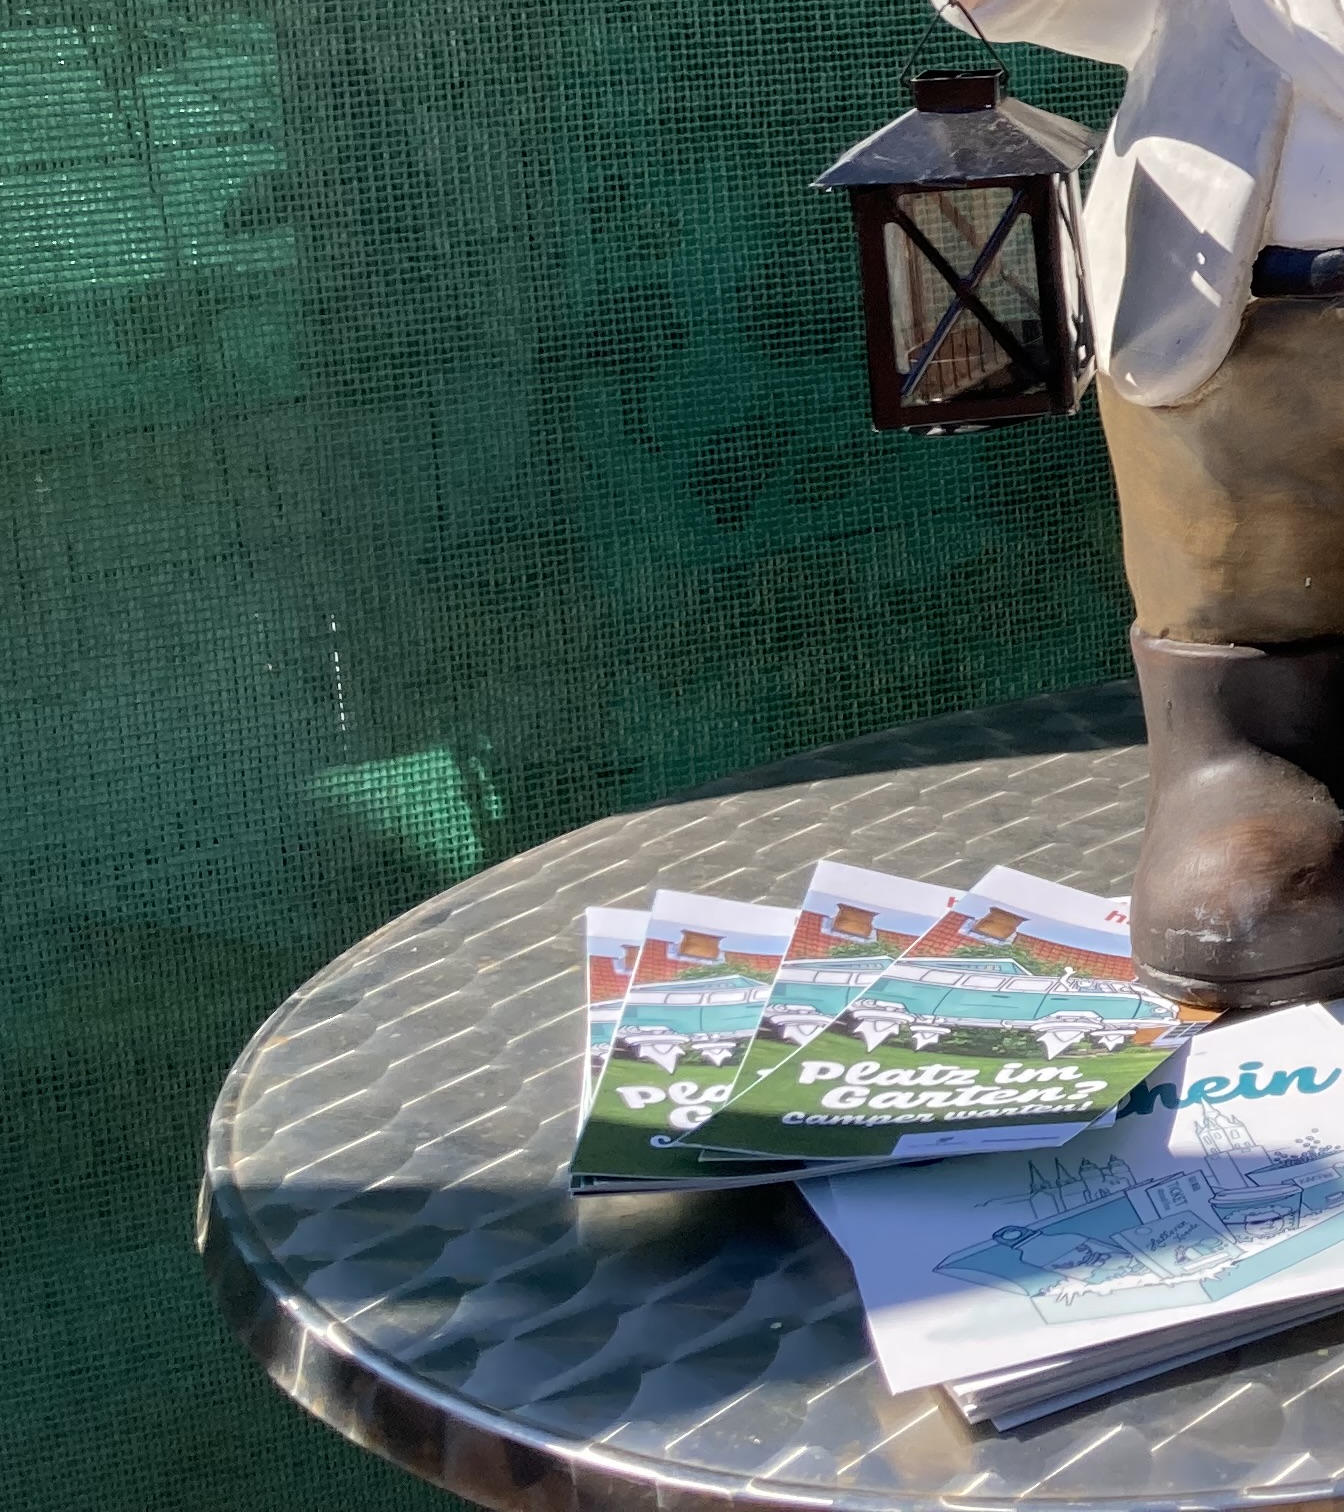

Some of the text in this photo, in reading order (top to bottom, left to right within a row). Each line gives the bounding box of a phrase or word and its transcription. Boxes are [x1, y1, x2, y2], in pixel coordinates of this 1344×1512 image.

[798, 1060, 1083, 1086] Platz im
[616, 1080, 732, 1109] Pla
[821, 1080, 1109, 1109] Garten?
[782, 1100, 1094, 1127] Camper warten!
